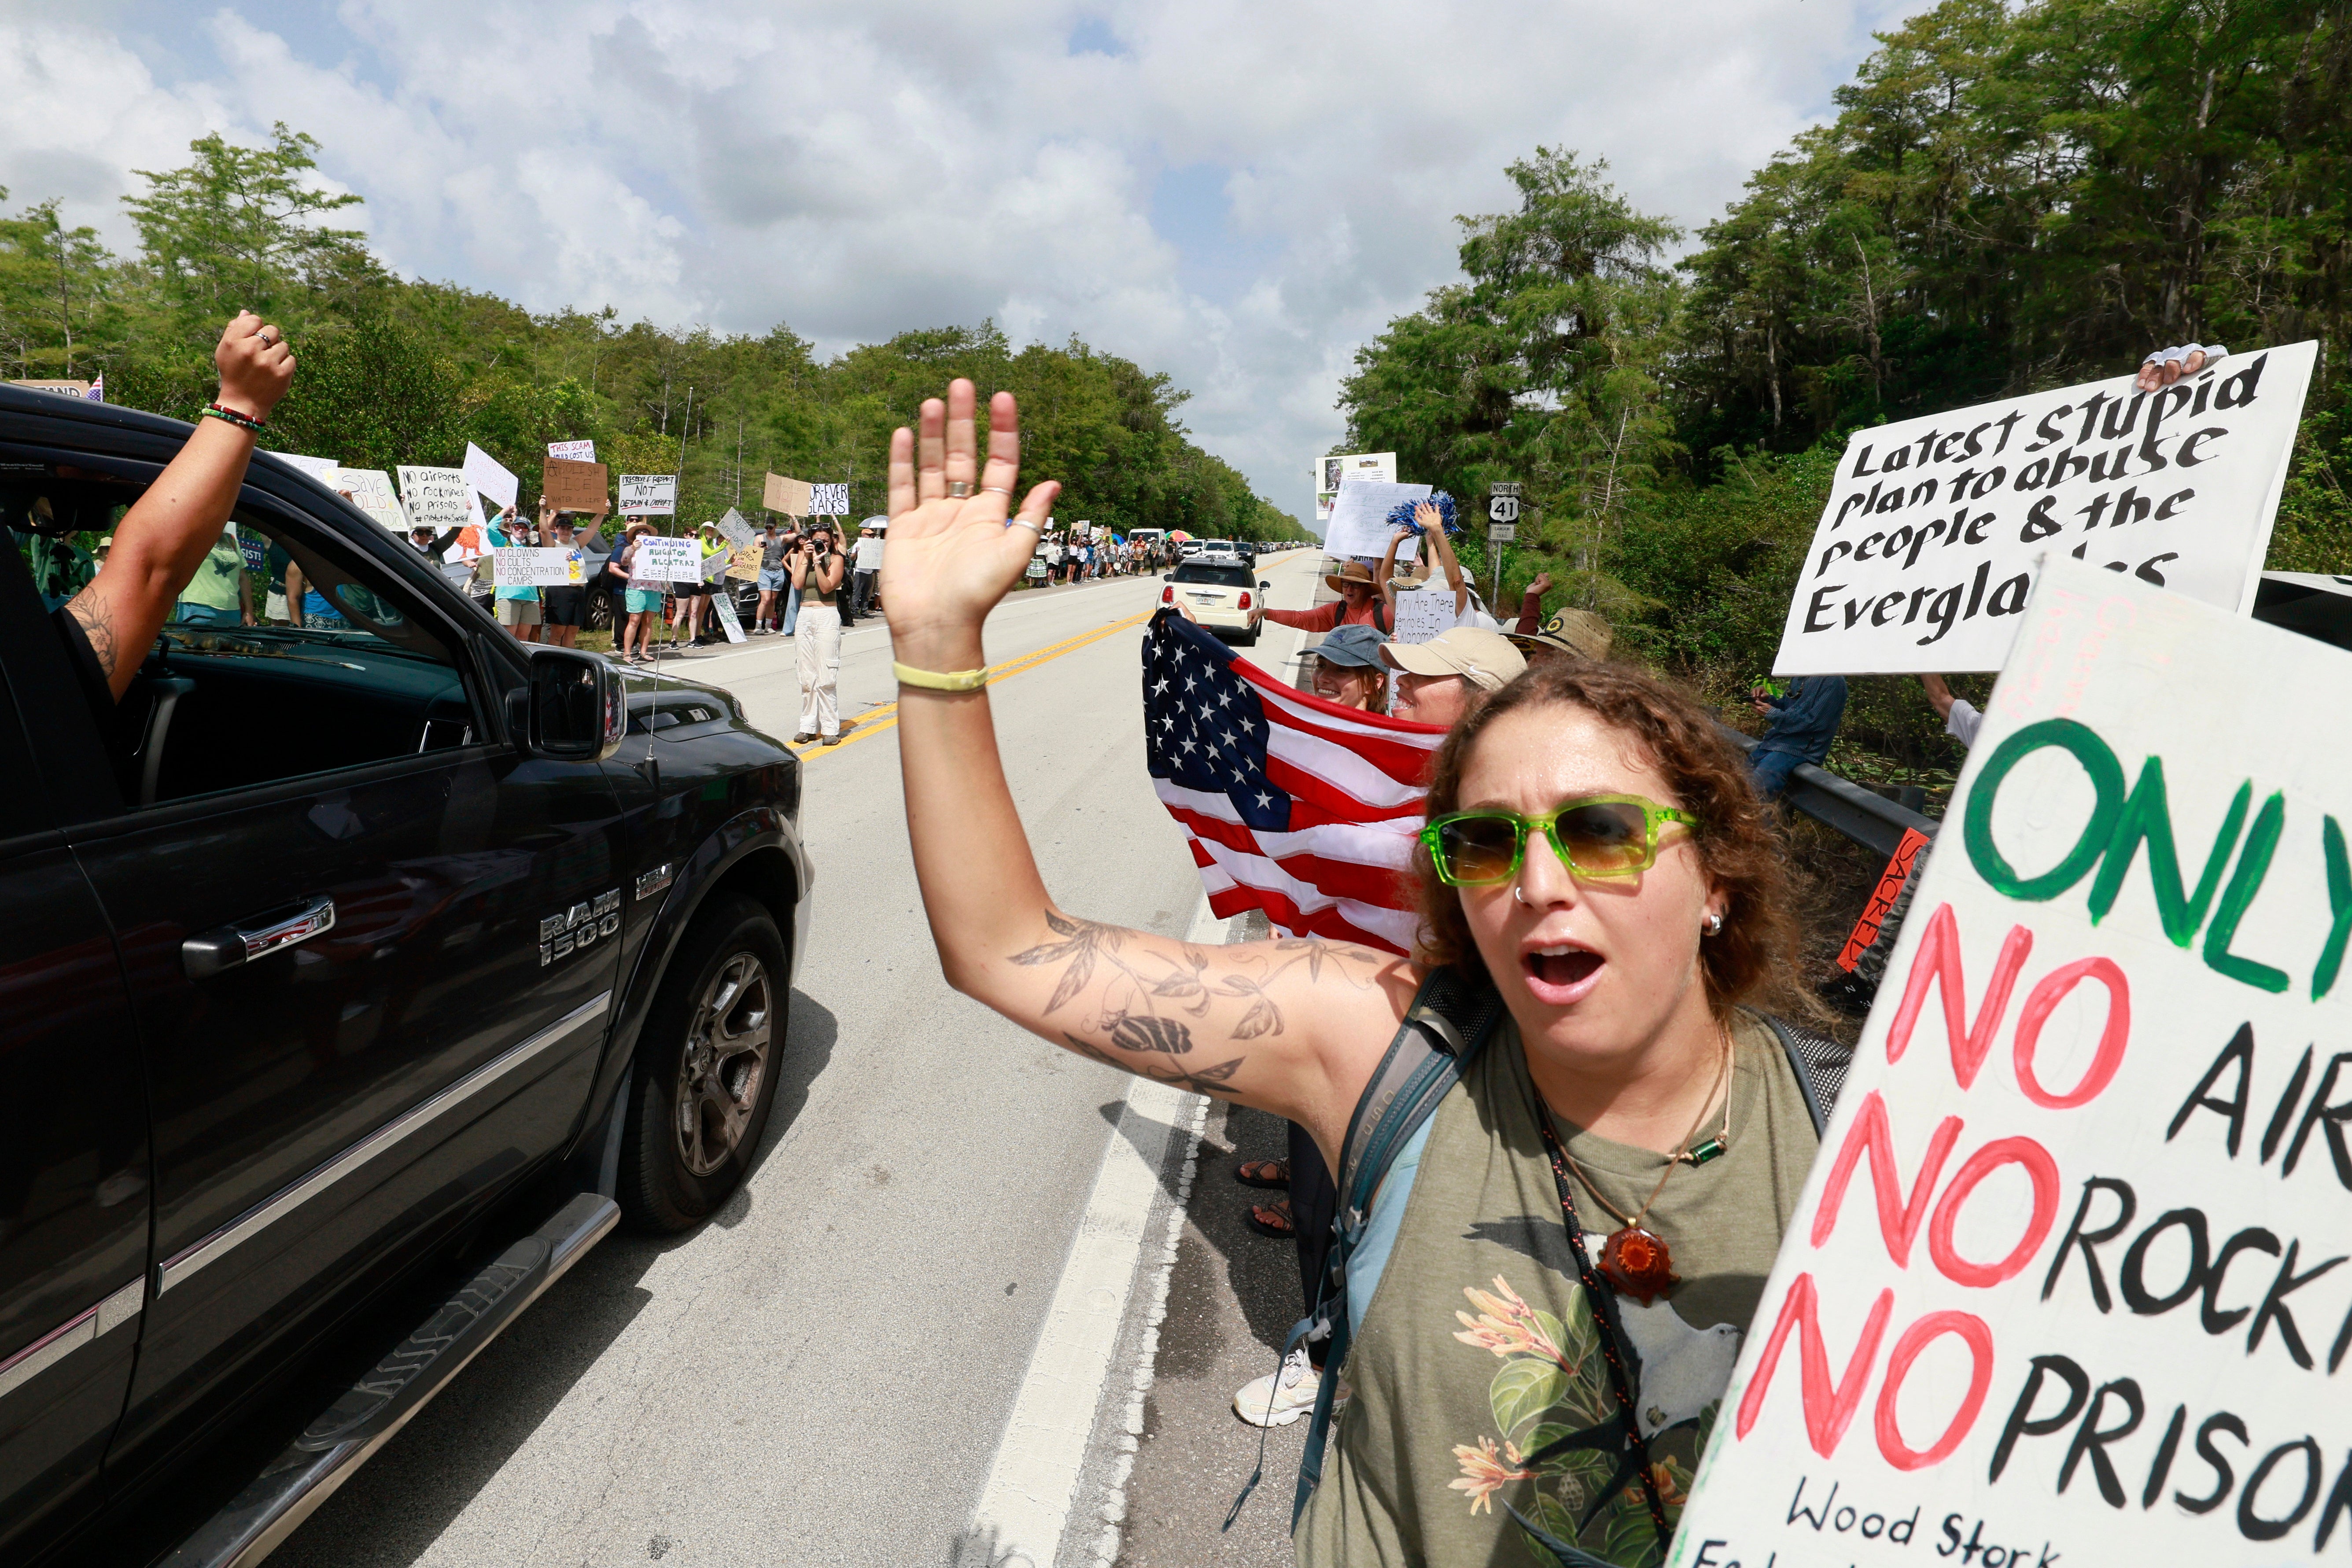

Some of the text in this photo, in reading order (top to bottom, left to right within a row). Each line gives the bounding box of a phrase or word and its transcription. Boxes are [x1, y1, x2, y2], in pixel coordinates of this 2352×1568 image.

[1851, 352, 2269, 479] Latest stupid
[550, 442, 590, 453] THIS SCAM
[472, 445, 510, 479] THE NAZIS
[546, 460, 600, 477] ABOLISH
[403, 471, 417, 487] NO
[489, 477, 507, 493] DOING
[562, 477, 592, 491] ICE
[1831, 427, 2229, 532] plan to abuse
[407, 488, 418, 501] NO
[634, 484, 656, 496] NOT
[776, 489, 798, 501] NOT
[1342, 484, 1370, 494] KEEP
[1375, 486, 1390, 494] THIS
[1403, 486, 1430, 495] SWAMP
[353, 494, 386, 509] OLD
[409, 501, 420, 515] NO
[620, 499, 644, 507] DETAIN
[649, 498, 673, 507] DEPORT
[1494, 502, 1513, 516] 41
[731, 511, 752, 534] PROTECT
[719, 521, 744, 548] EVERGLADES
[1814, 485, 2197, 579] people & the
[496, 548, 539, 557] NO CLOWNS
[496, 558, 531, 567] NO CULTS
[496, 567, 564, 576] NO CONCENTRATION
[642, 568, 697, 581] CRIMINAL
[508, 576, 533, 585] CAMPS
[715, 595, 729, 605] SAVE
[1802, 541, 2179, 647] Everglas
[720, 604, 730, 614] THE
[1396, 593, 1454, 617] Why Are There
[721, 613, 737, 623] GLADES
[1395, 613, 1441, 629] Seminoles In
[1963, 717, 2352, 1003] ONLY
[636, 862, 672, 890] HEMI
[1849, 836, 1923, 964] SACRED
[540, 887, 620, 942] RAM
[539, 912, 619, 967] 1500
[1886, 901, 2131, 1109] NO
[1810, 1089, 2352, 1376] NO ROCK
[1735, 1272, 1994, 1472] NO
[1786, 1476, 2062, 1568] Wood Stork
